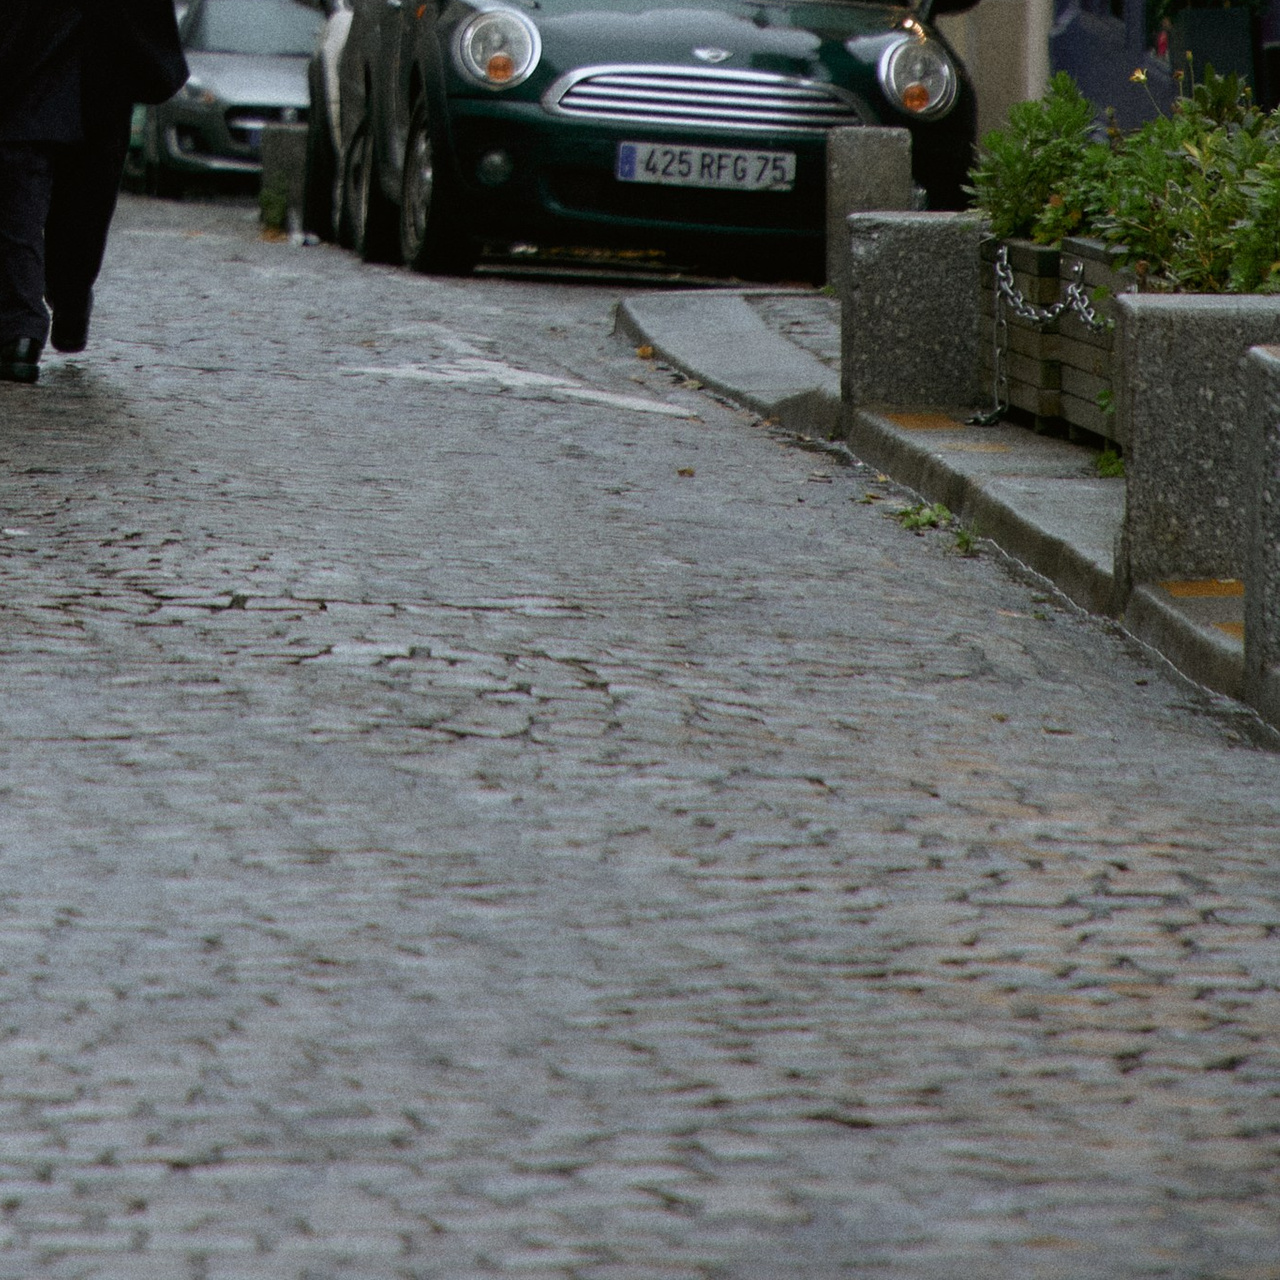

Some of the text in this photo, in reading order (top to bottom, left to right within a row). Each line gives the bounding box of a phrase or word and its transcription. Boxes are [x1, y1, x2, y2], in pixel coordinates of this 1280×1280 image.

[644, 149, 692, 178] 425
[699, 152, 748, 182] RFG
[754, 155, 787, 184] 75
